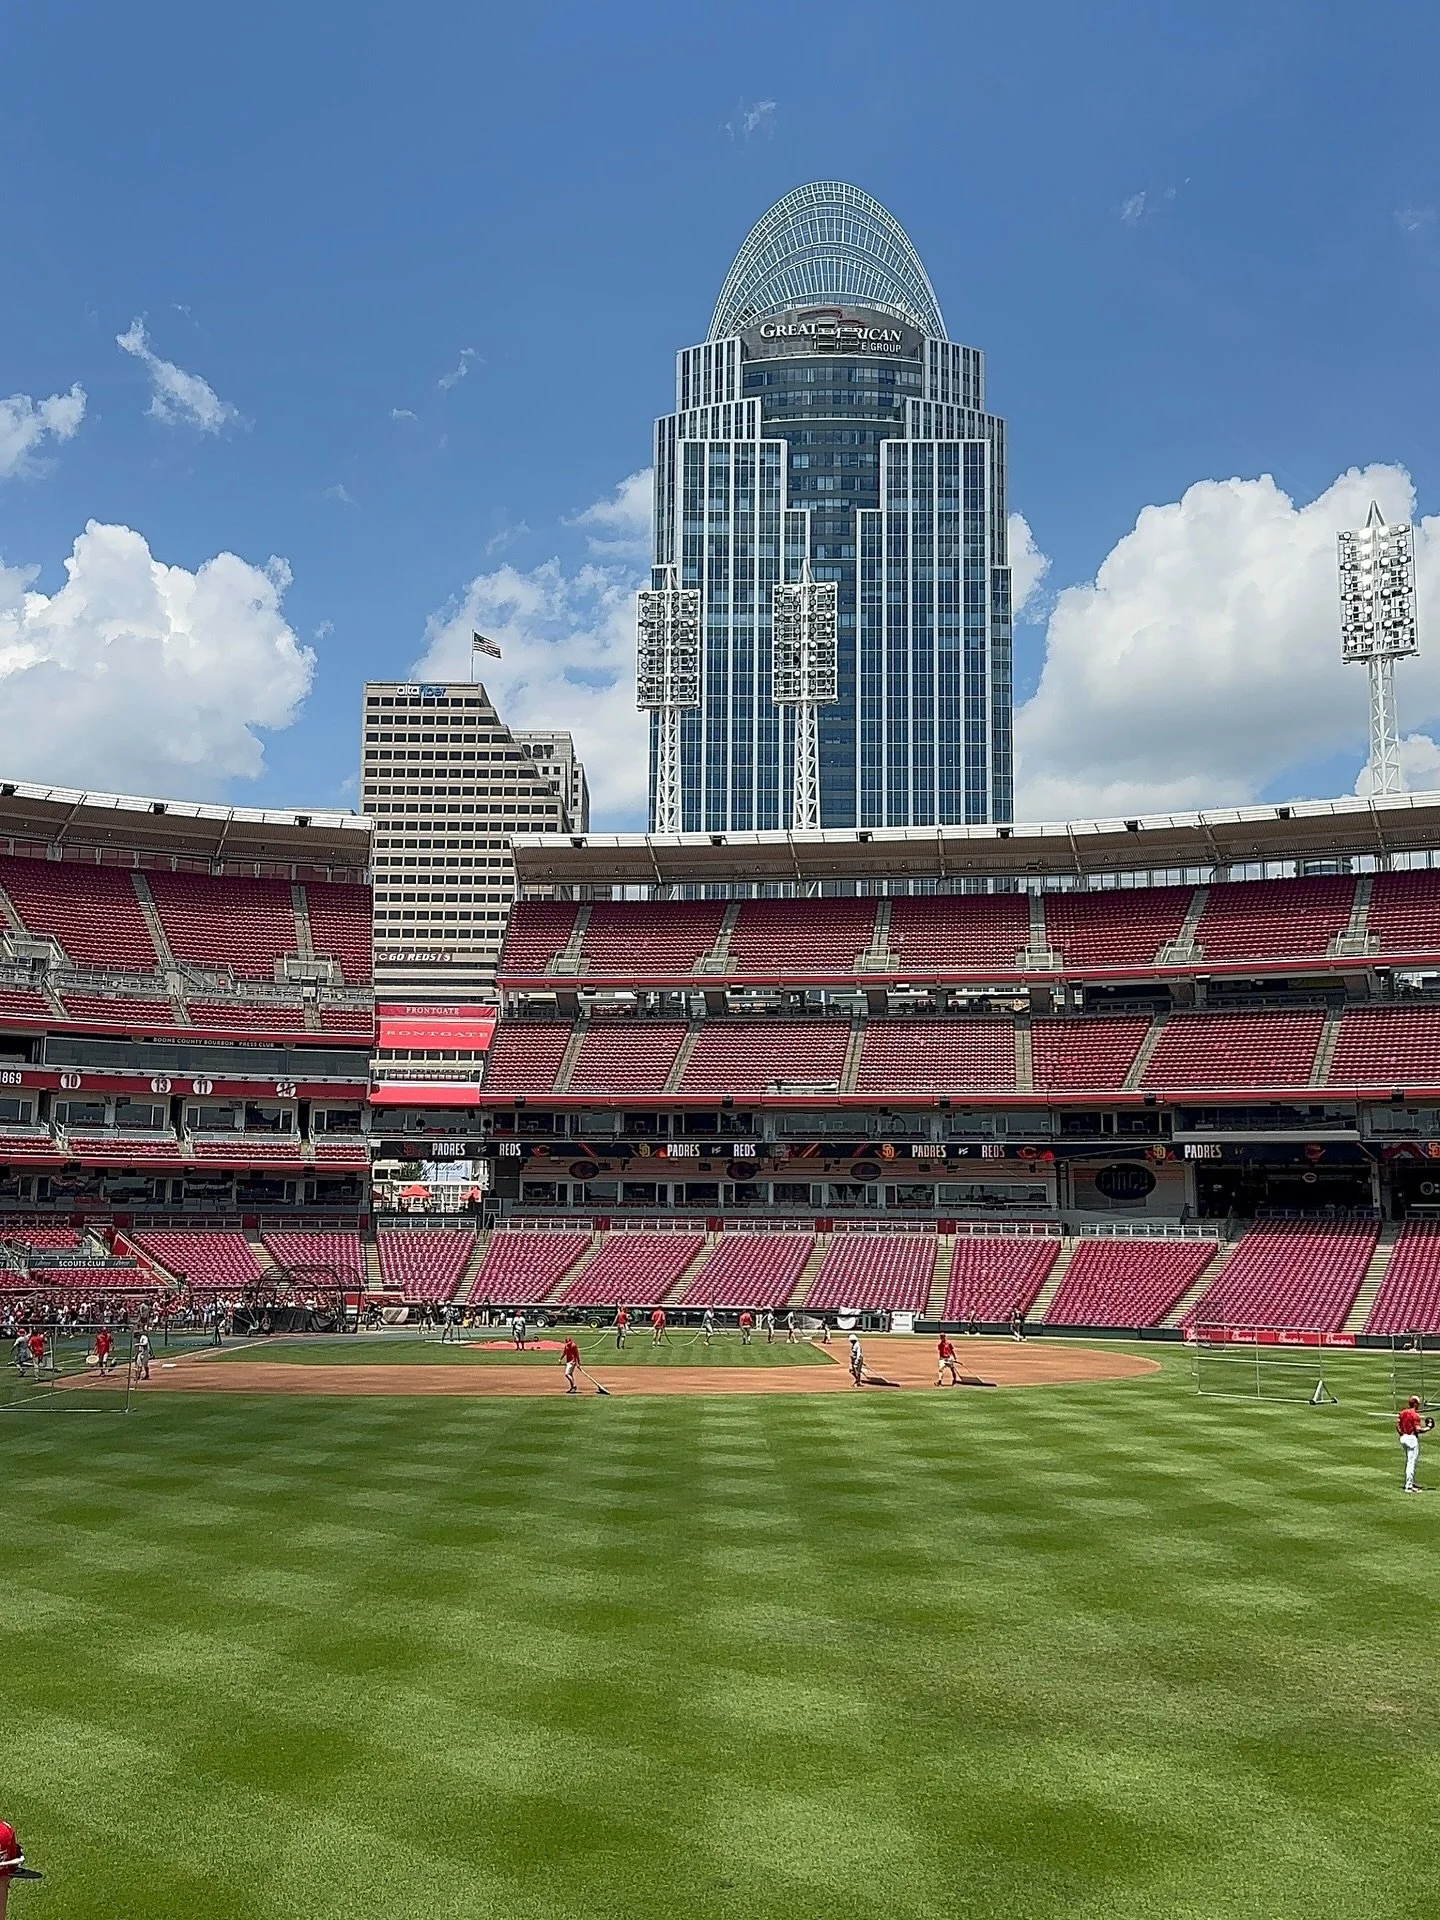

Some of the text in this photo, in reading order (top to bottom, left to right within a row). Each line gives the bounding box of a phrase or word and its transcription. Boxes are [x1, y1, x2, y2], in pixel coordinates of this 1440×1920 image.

[760, 322, 818, 339] GREAT
[870, 341, 902, 353] GROUP
[389, 952, 404, 961] GO
[406, 1006, 460, 1015] FRONTGATE
[64, 1074, 78, 1088] 10
[156, 1079, 167, 1092] 13
[197, 1080, 208, 1093] 11
[432, 1143, 466, 1156] PADRES
[499, 1143, 521, 1156] REDS
[667, 1144, 700, 1157] PADRES
[733, 1144, 756, 1157] REDS
[911, 1145, 947, 1158] PADRES
[981, 1145, 1005, 1158] REDS
[1184, 1144, 1222, 1158] PADRES
